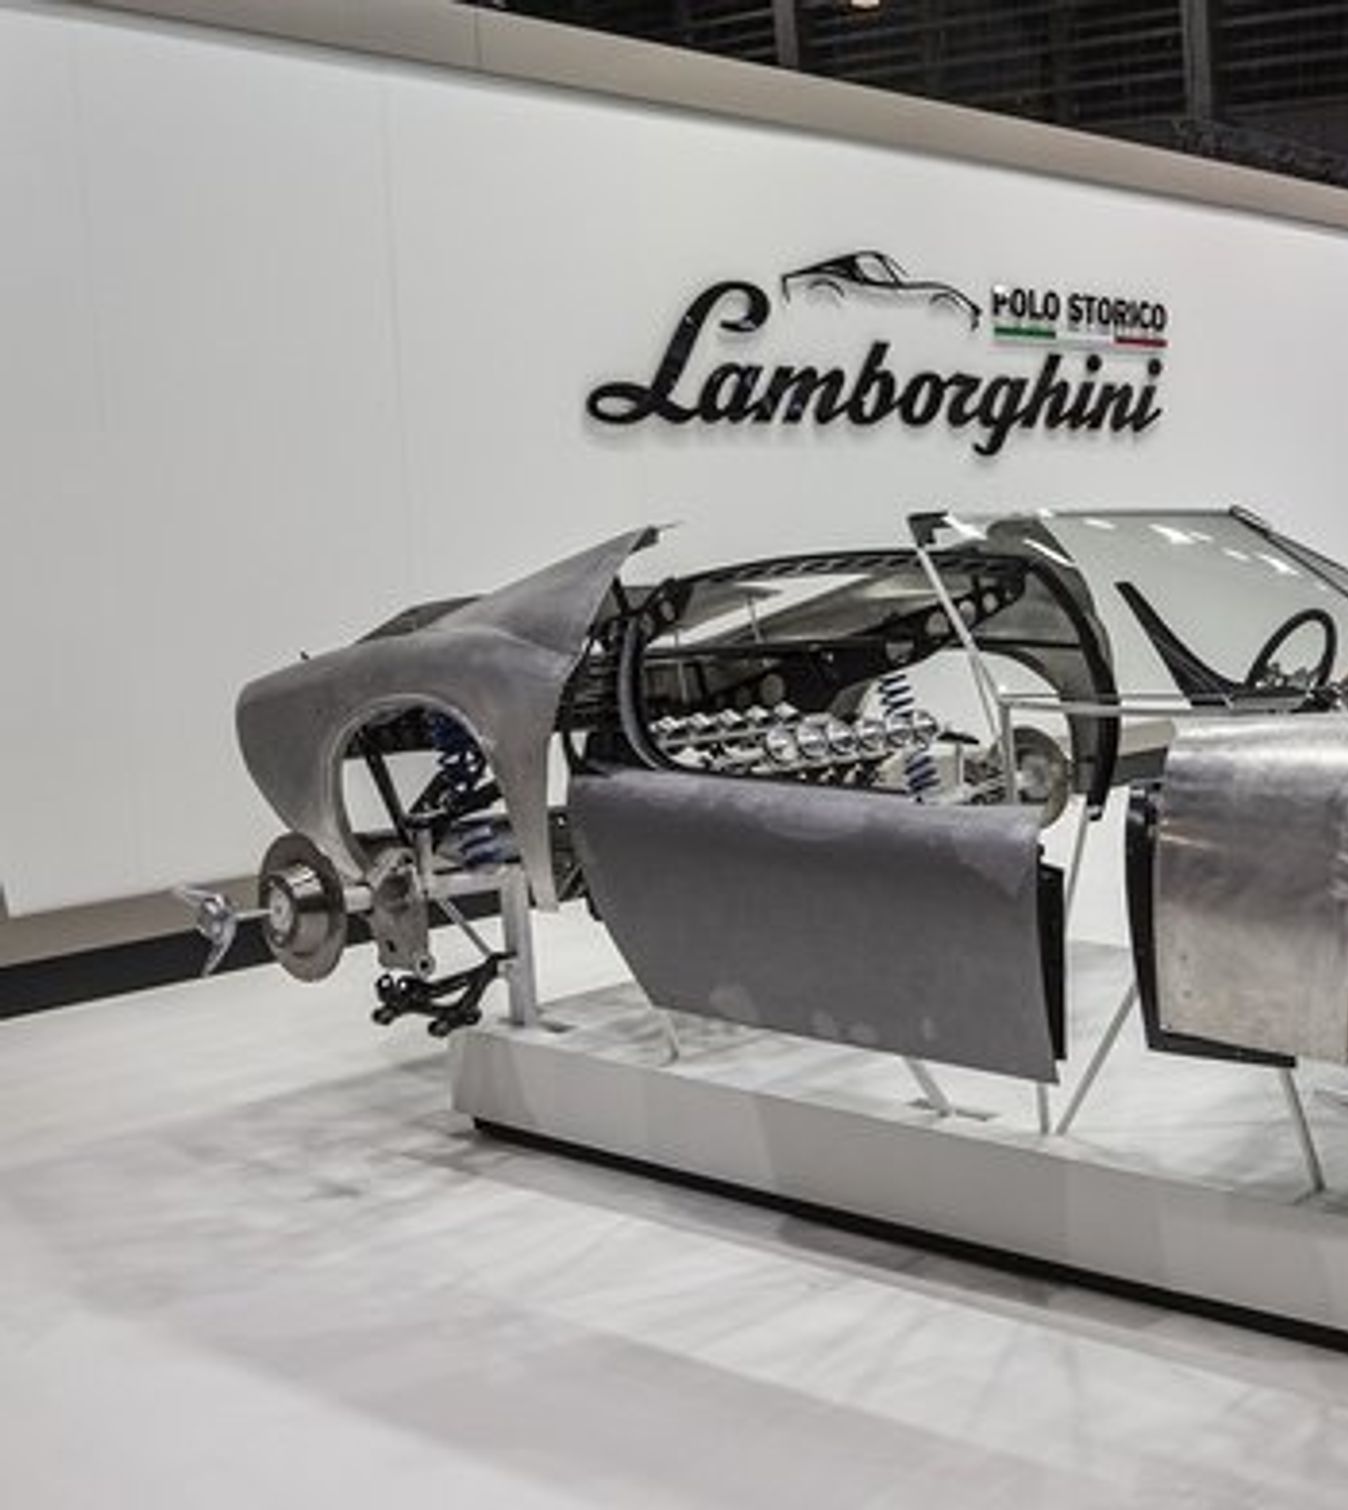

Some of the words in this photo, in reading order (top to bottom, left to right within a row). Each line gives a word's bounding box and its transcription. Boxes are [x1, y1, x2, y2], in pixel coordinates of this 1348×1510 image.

[992, 288, 1060, 321] POLO
[1067, 293, 1168, 332] STORICO
[586, 280, 1163, 455] Lamborghini
